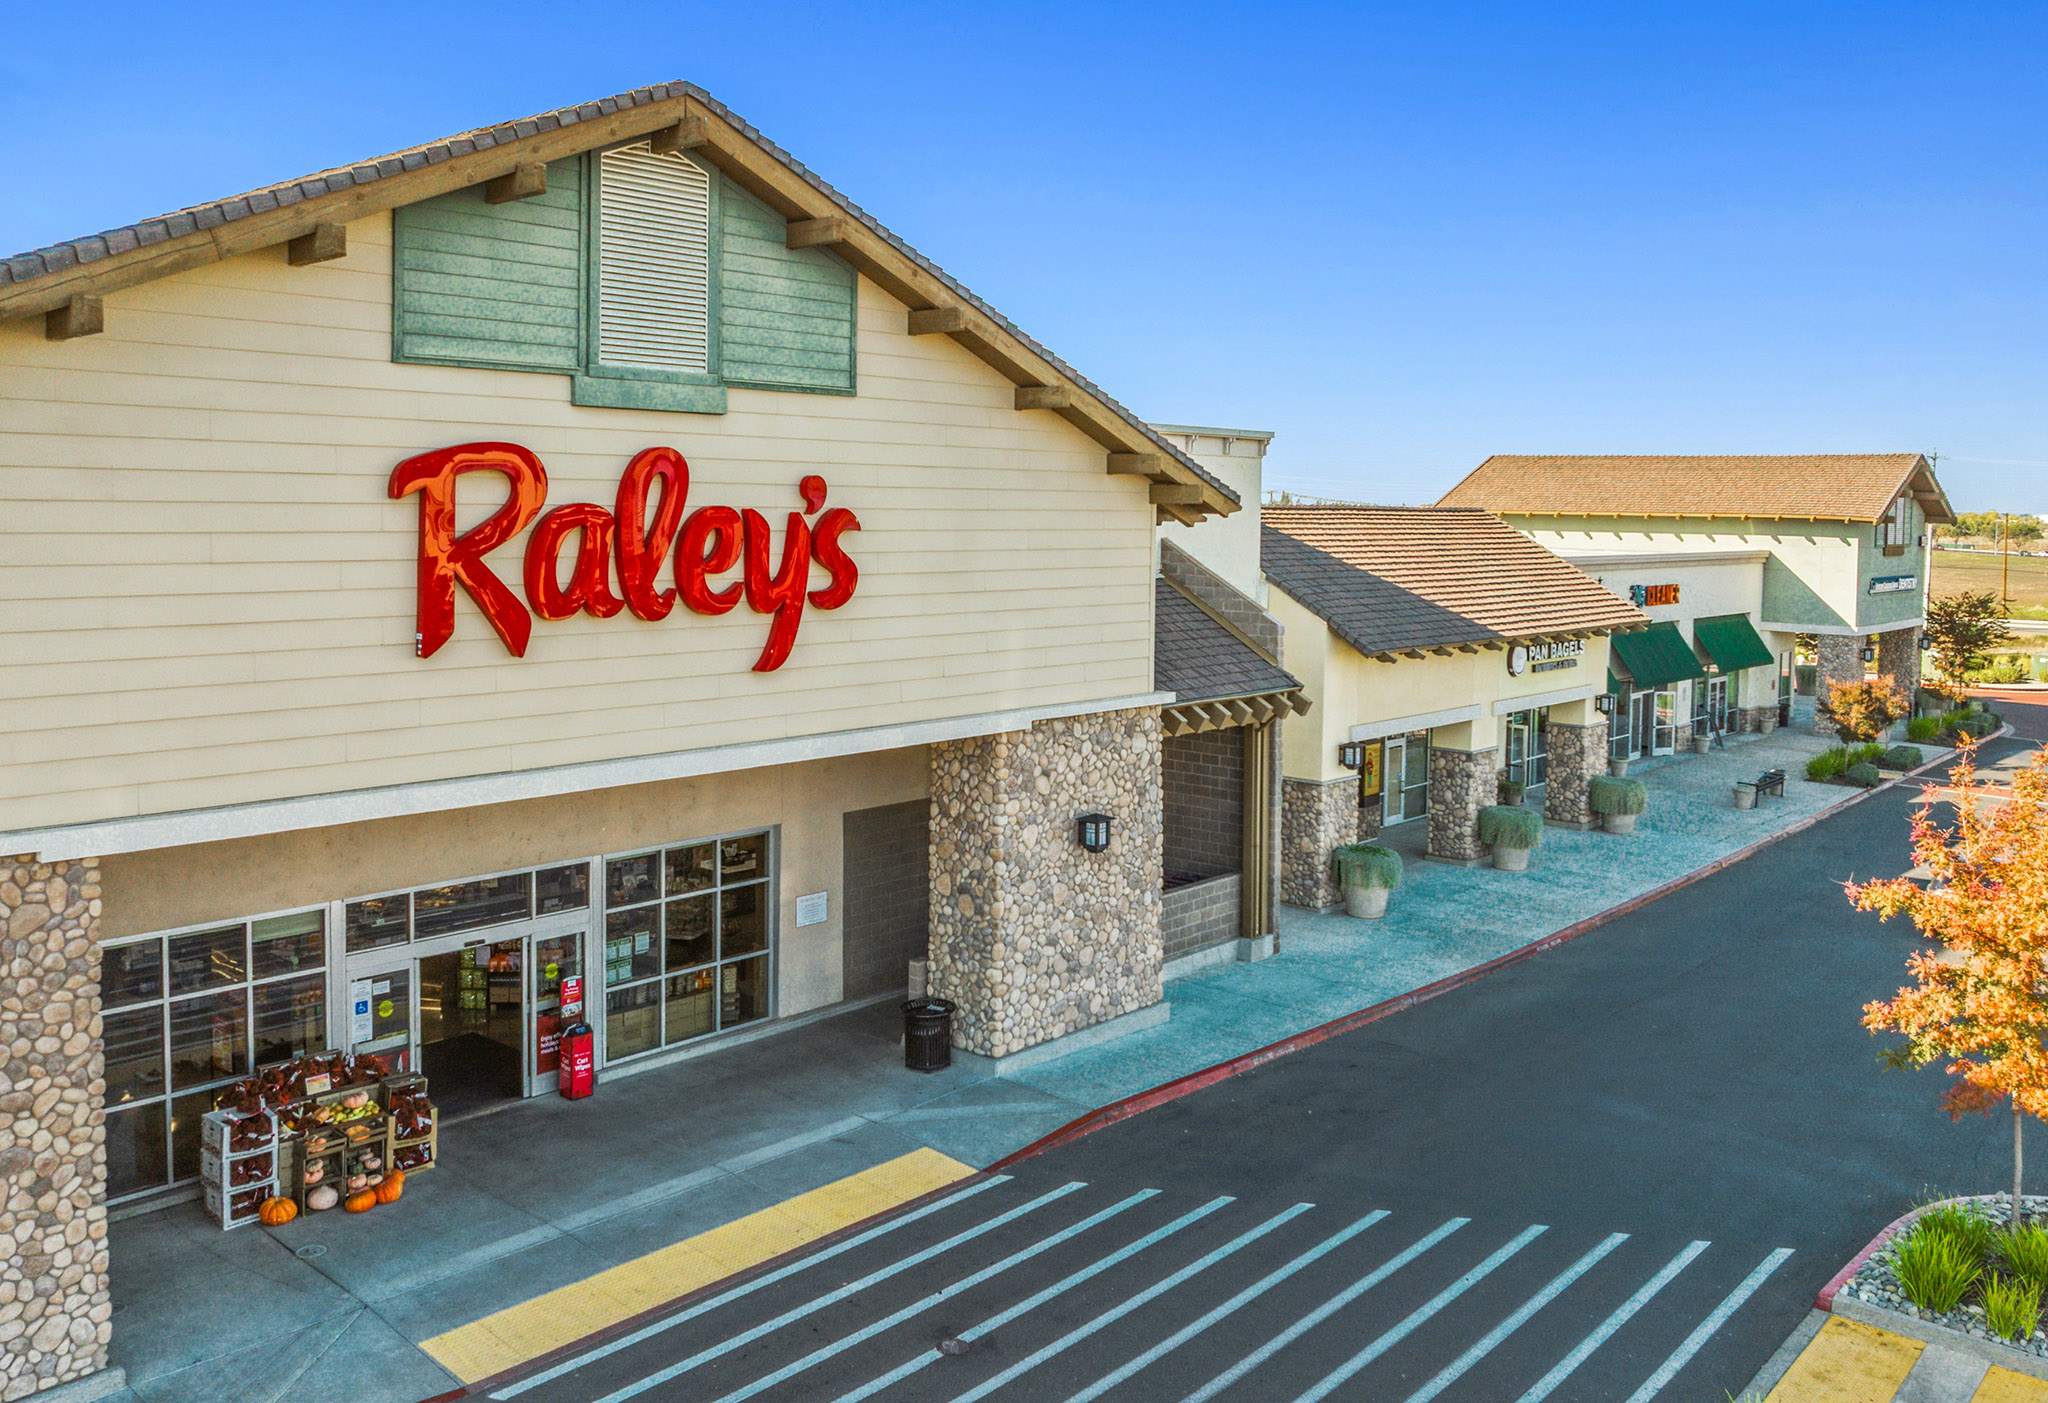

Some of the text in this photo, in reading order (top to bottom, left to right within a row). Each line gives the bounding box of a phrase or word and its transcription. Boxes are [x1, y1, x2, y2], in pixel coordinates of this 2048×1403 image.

[388, 441, 861, 672] Raley's
[1527, 639, 1586, 661] PAN BAGELS
